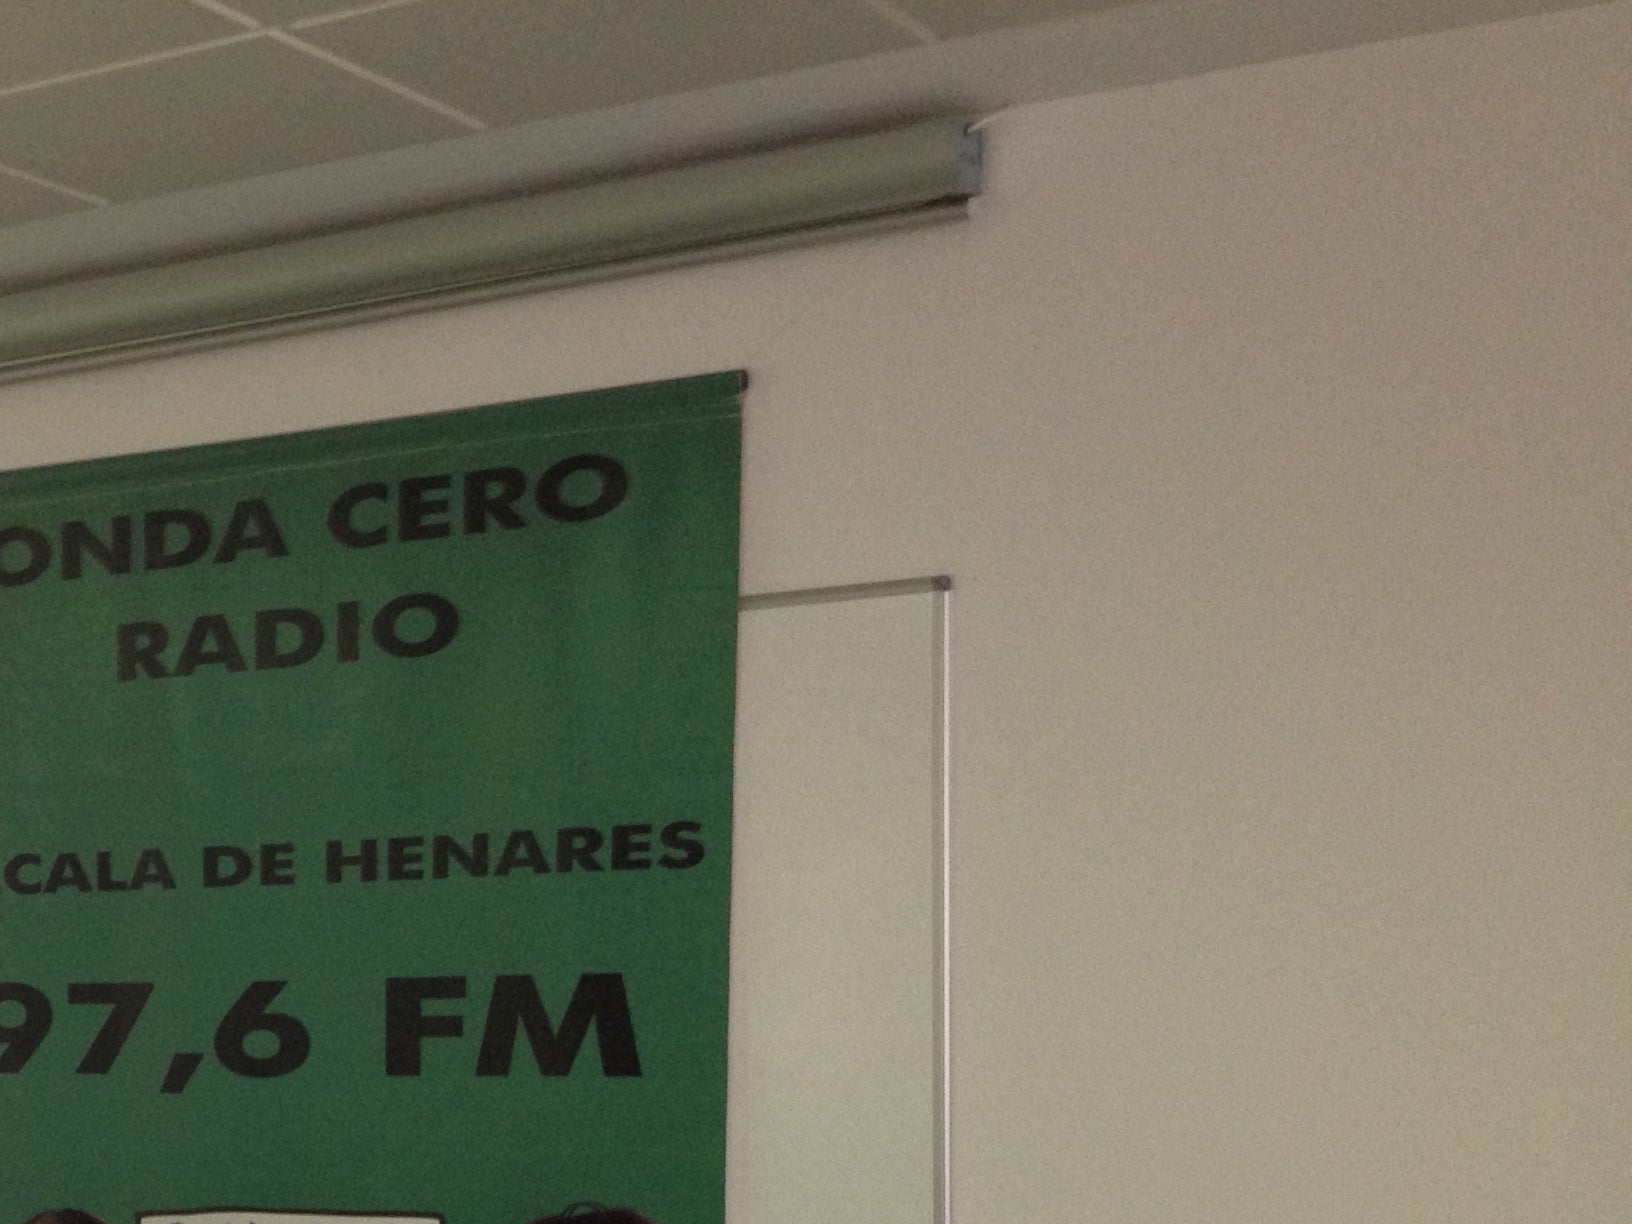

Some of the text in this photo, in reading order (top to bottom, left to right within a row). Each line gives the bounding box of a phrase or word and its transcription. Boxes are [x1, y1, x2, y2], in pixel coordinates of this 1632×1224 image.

[327, 454, 630, 549] CERO
[115, 592, 460, 682] RADIO
[202, 843, 296, 888] DE
[325, 821, 706, 884] HENARES
[384, 972, 644, 1078] FM
